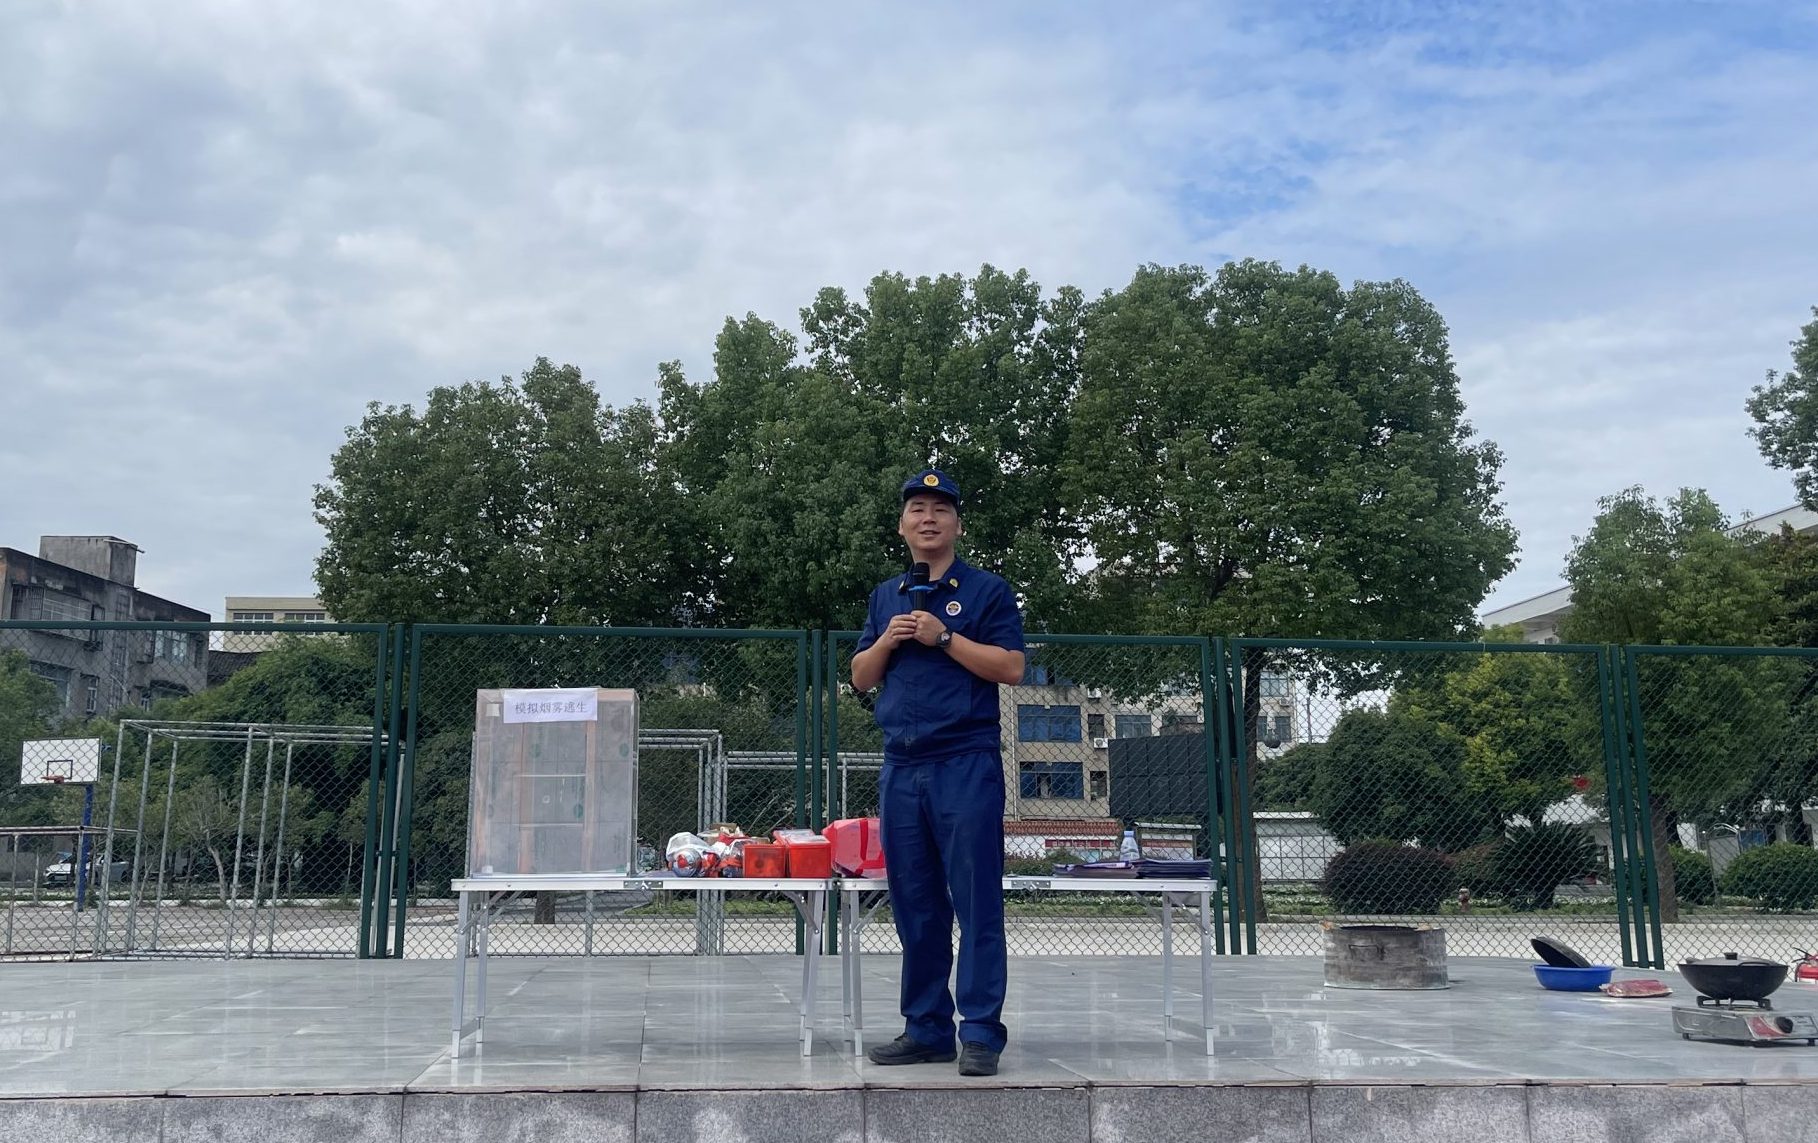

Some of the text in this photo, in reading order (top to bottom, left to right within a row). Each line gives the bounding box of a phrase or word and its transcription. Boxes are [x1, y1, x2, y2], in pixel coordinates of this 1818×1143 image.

[514, 701, 588, 714] 模拟烟雾逃生
